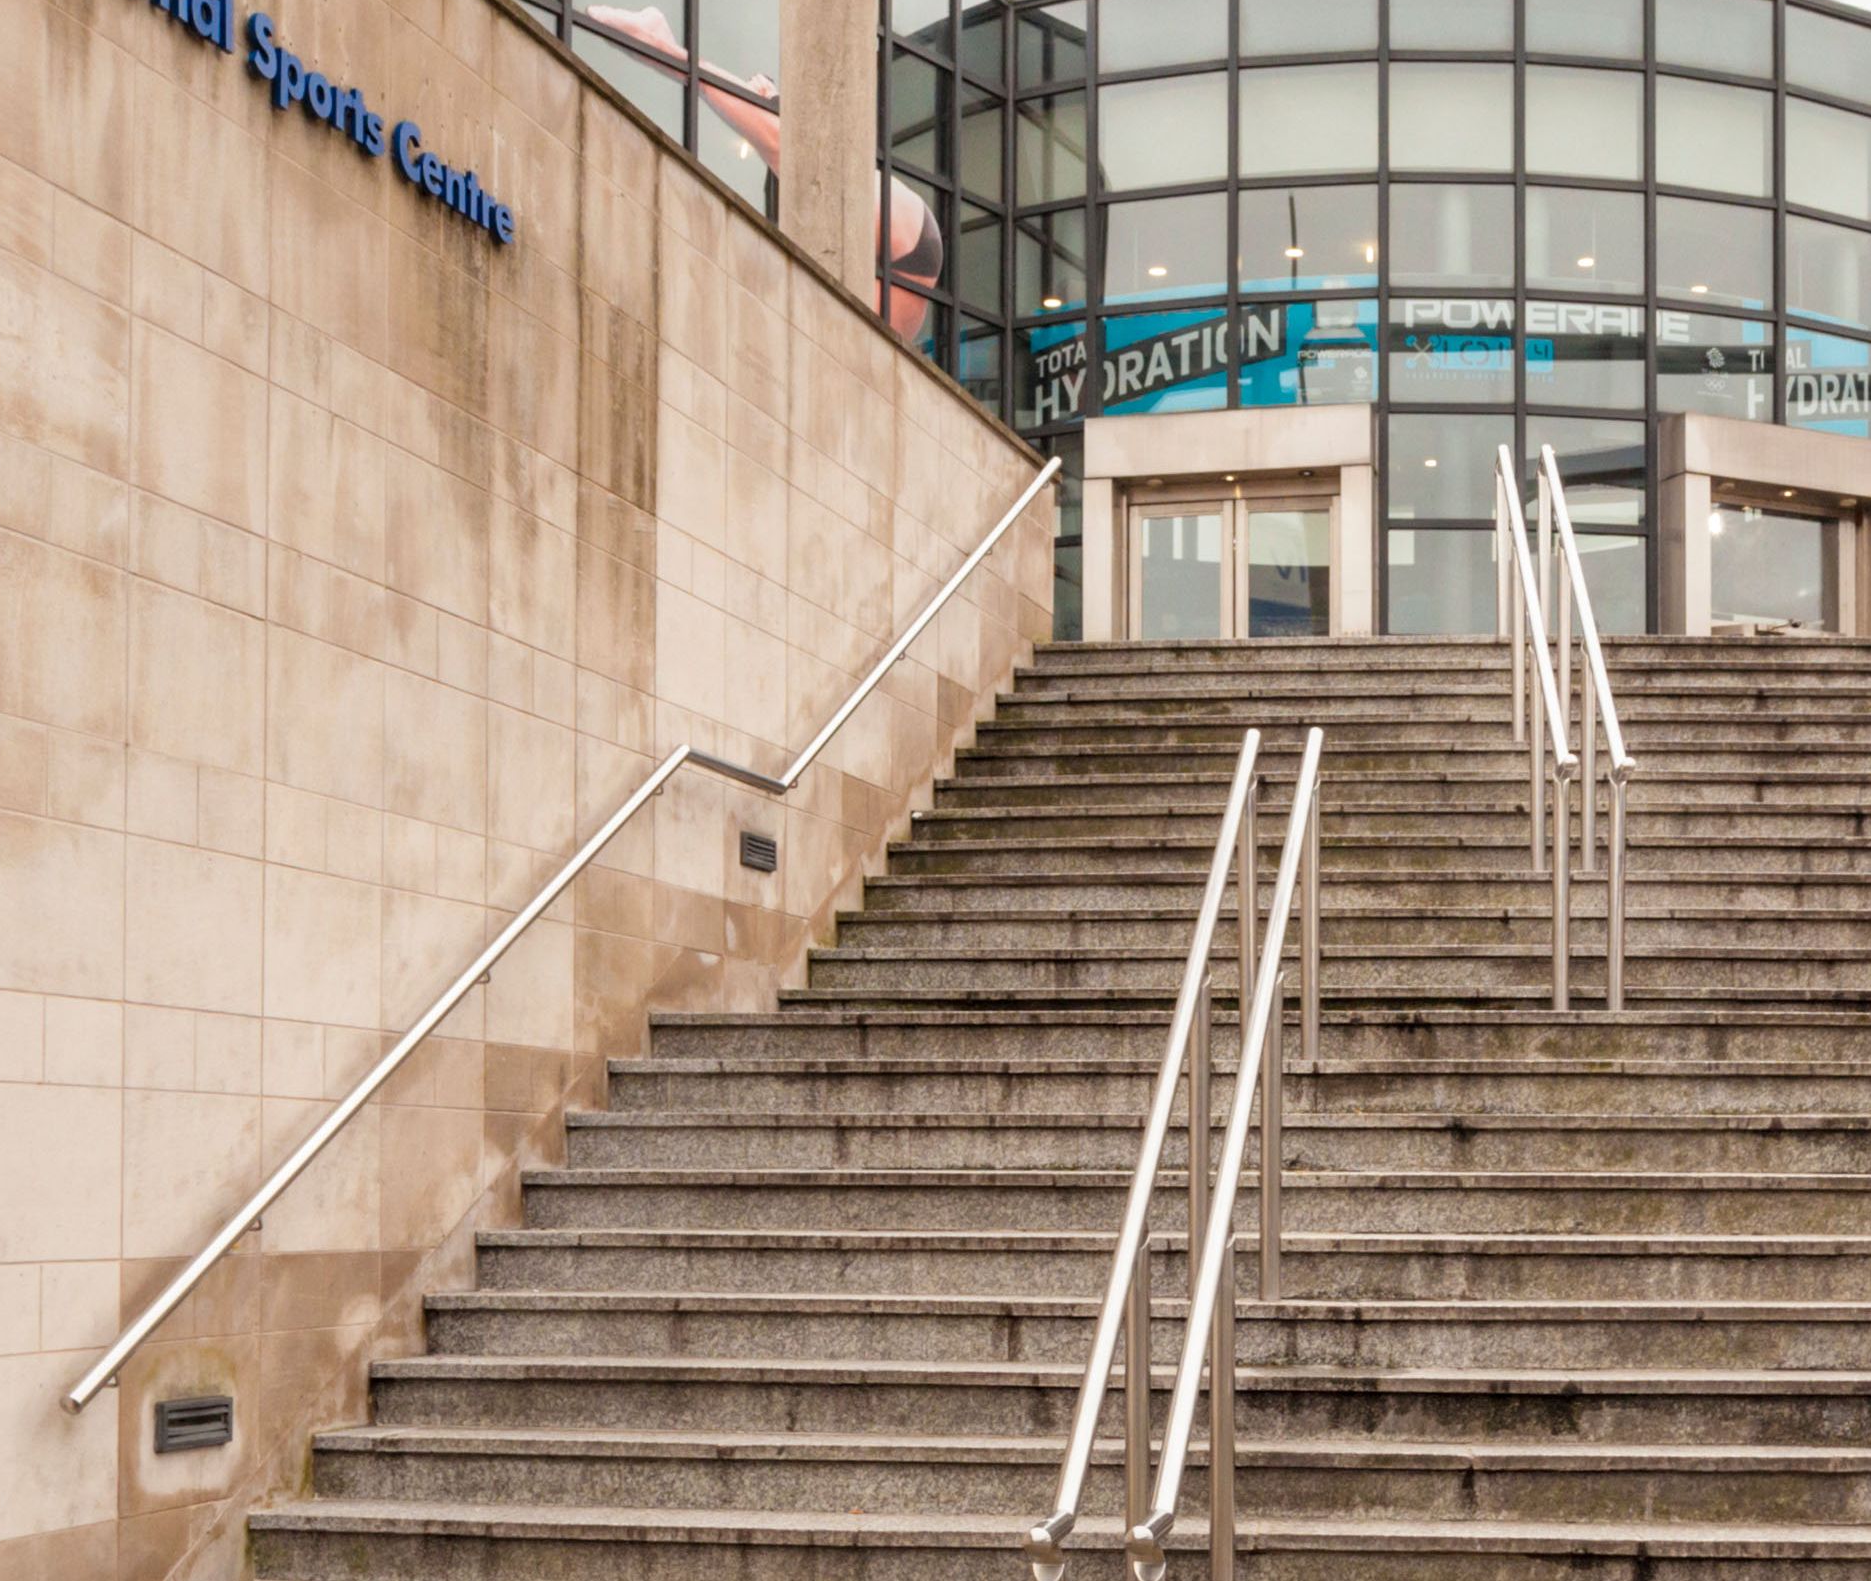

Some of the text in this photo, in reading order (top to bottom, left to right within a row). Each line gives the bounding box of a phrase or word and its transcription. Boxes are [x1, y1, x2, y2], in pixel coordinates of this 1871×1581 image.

[247, 12, 385, 157] Sports
[392, 120, 515, 244] Centre
[1035, 340, 1088, 379] TOTA
